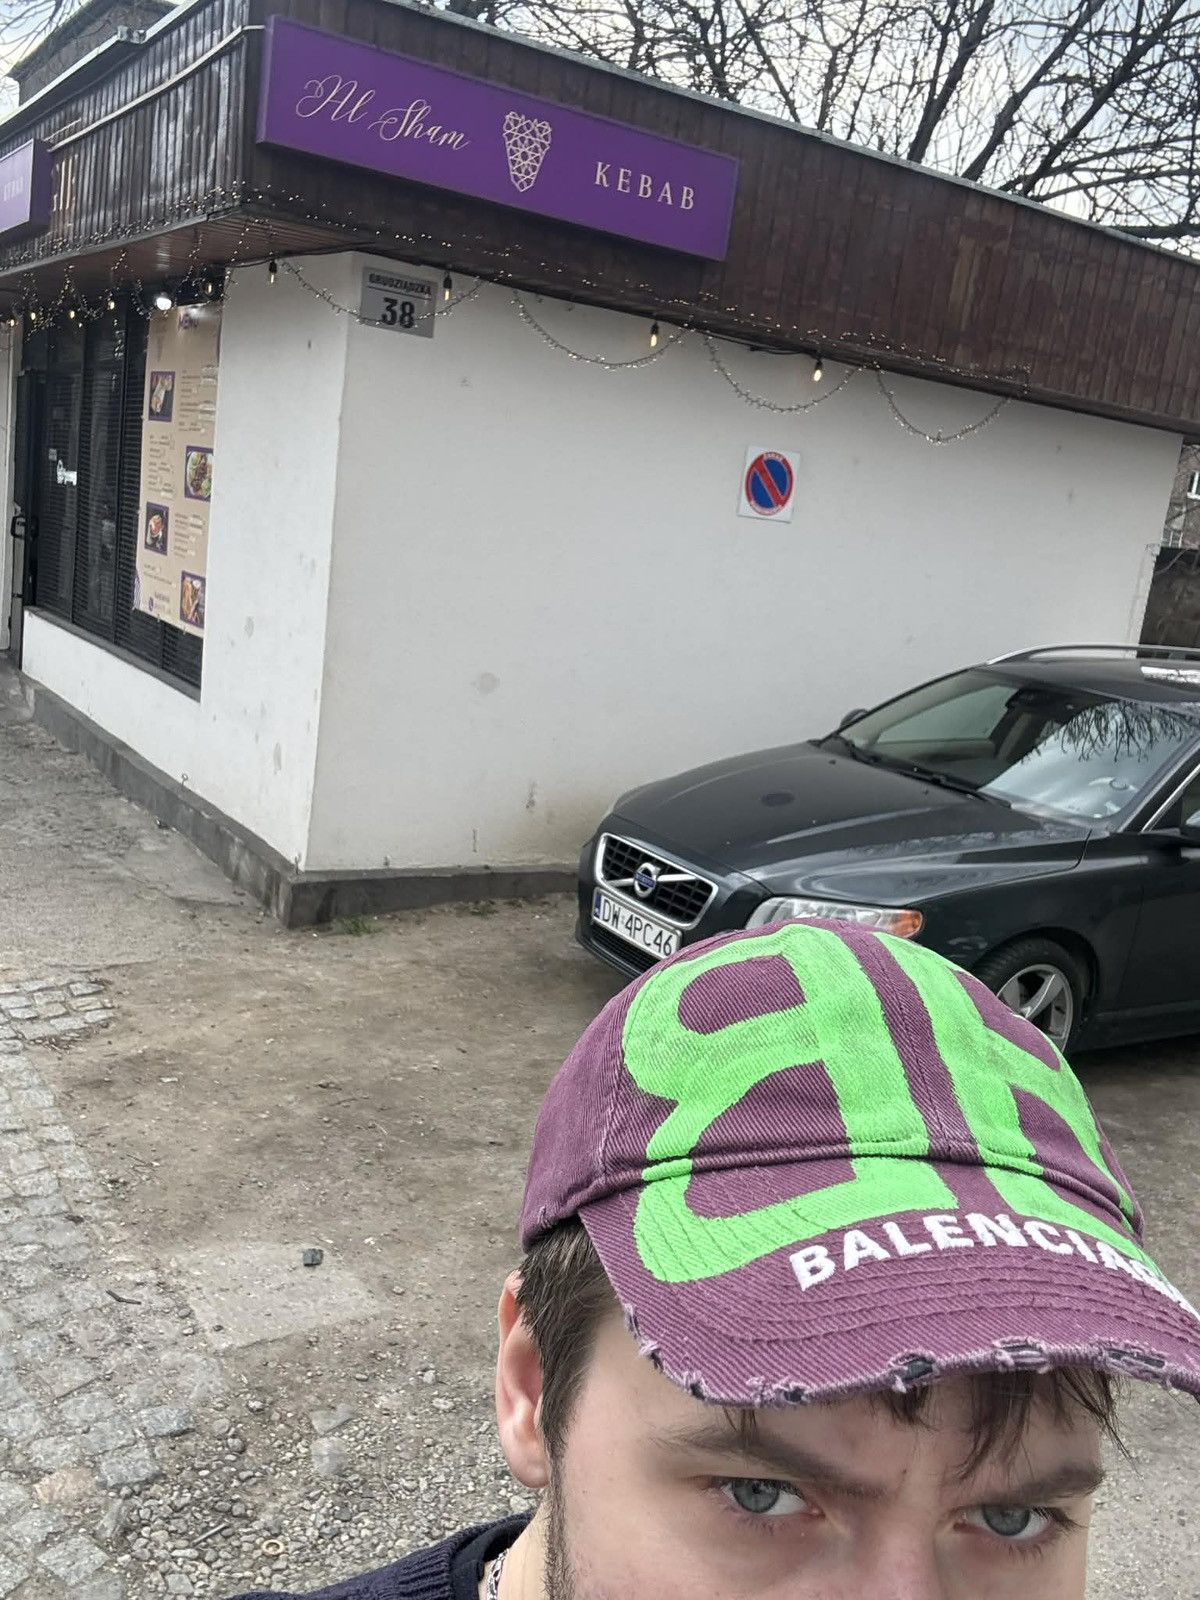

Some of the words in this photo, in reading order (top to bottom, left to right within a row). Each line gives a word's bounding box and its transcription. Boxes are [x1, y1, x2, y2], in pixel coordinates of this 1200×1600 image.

[296, 74, 376, 123] Al
[367, 99, 471, 151] Sham
[594, 161, 695, 210] KEBAB
[381, 297, 415, 329] 38
[602, 898, 621, 931] DW
[624, 913, 673, 957] 4PC46
